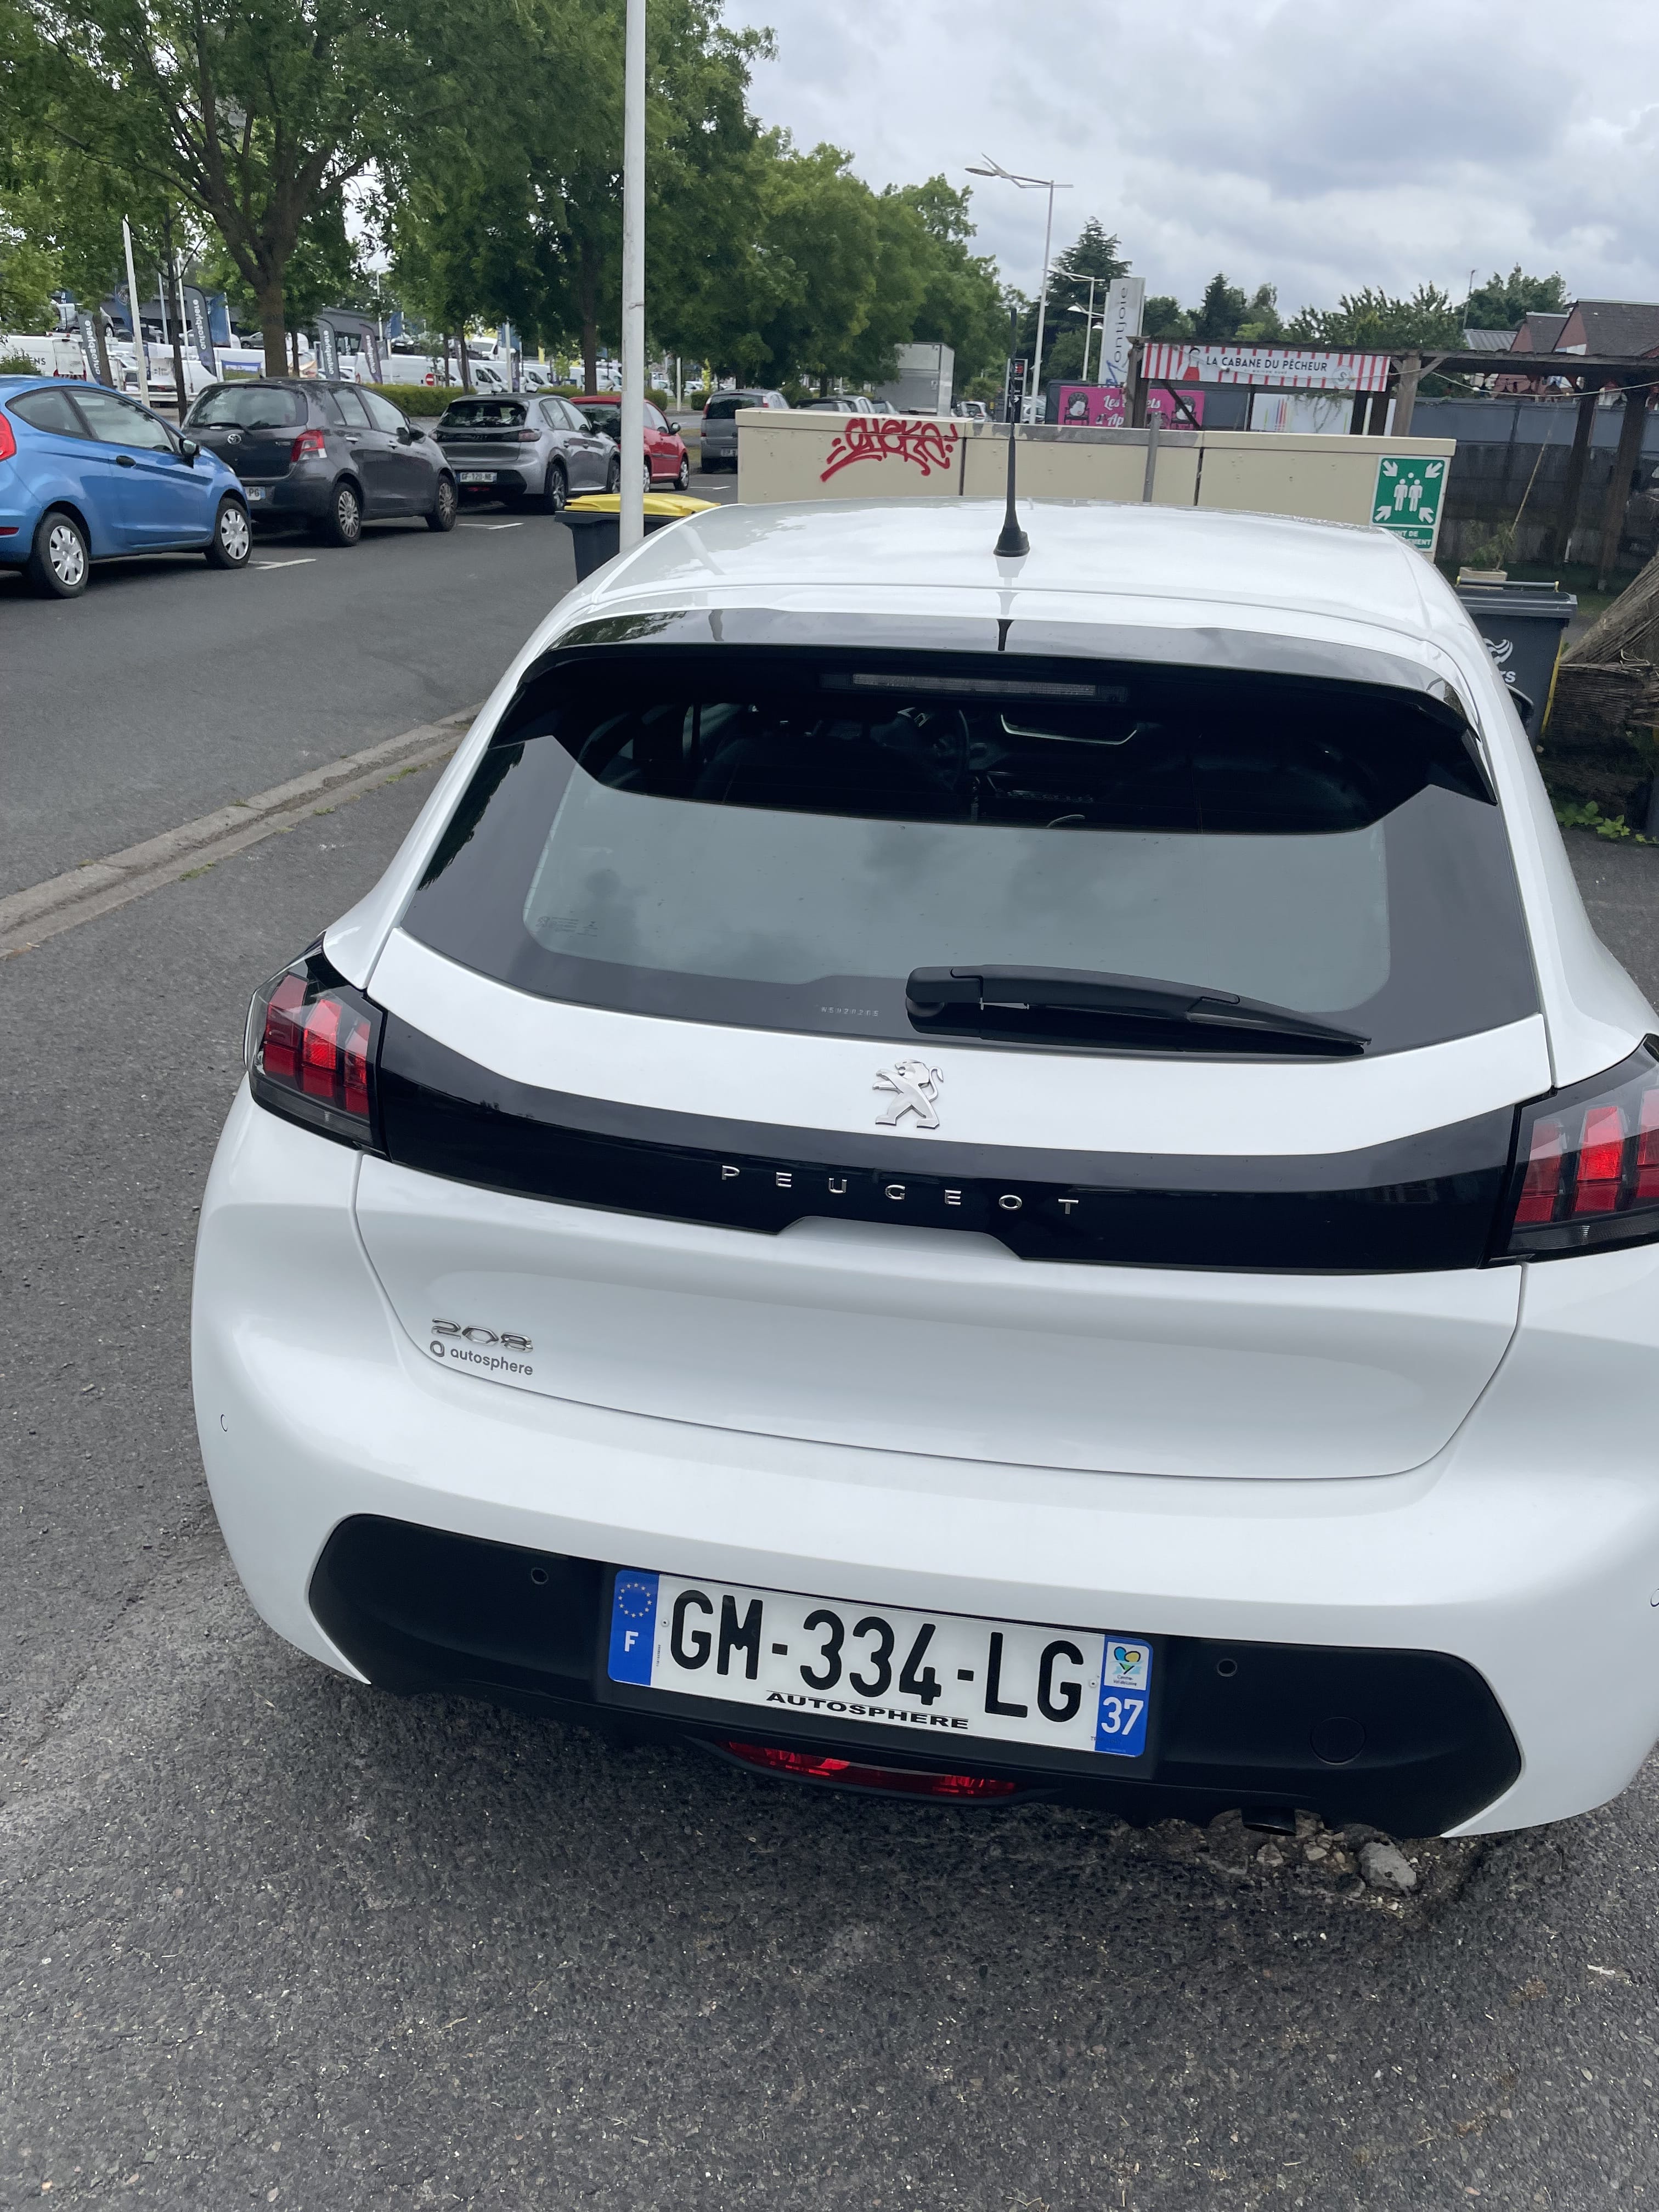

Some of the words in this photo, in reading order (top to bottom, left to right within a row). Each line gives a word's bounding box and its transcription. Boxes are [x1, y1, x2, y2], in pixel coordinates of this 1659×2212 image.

[1206, 356, 1217, 365] LA
[1222, 357, 1261, 368] CABANE
[1265, 359, 1279, 369] DU
[1283, 359, 1328, 372] PÊCHEUR
[1104, 395, 1119, 410] Les
[721, 1165, 1079, 1215] PEUGEOT
[431, 1318, 533, 1353] 208
[450, 1348, 533, 1375] autosphere
[624, 1630, 639, 1652] F
[670, 1589, 1084, 1723] GM-334-LG
[766, 1692, 969, 1730] AUTOSPHERE
[1101, 1696, 1144, 1736] 37
